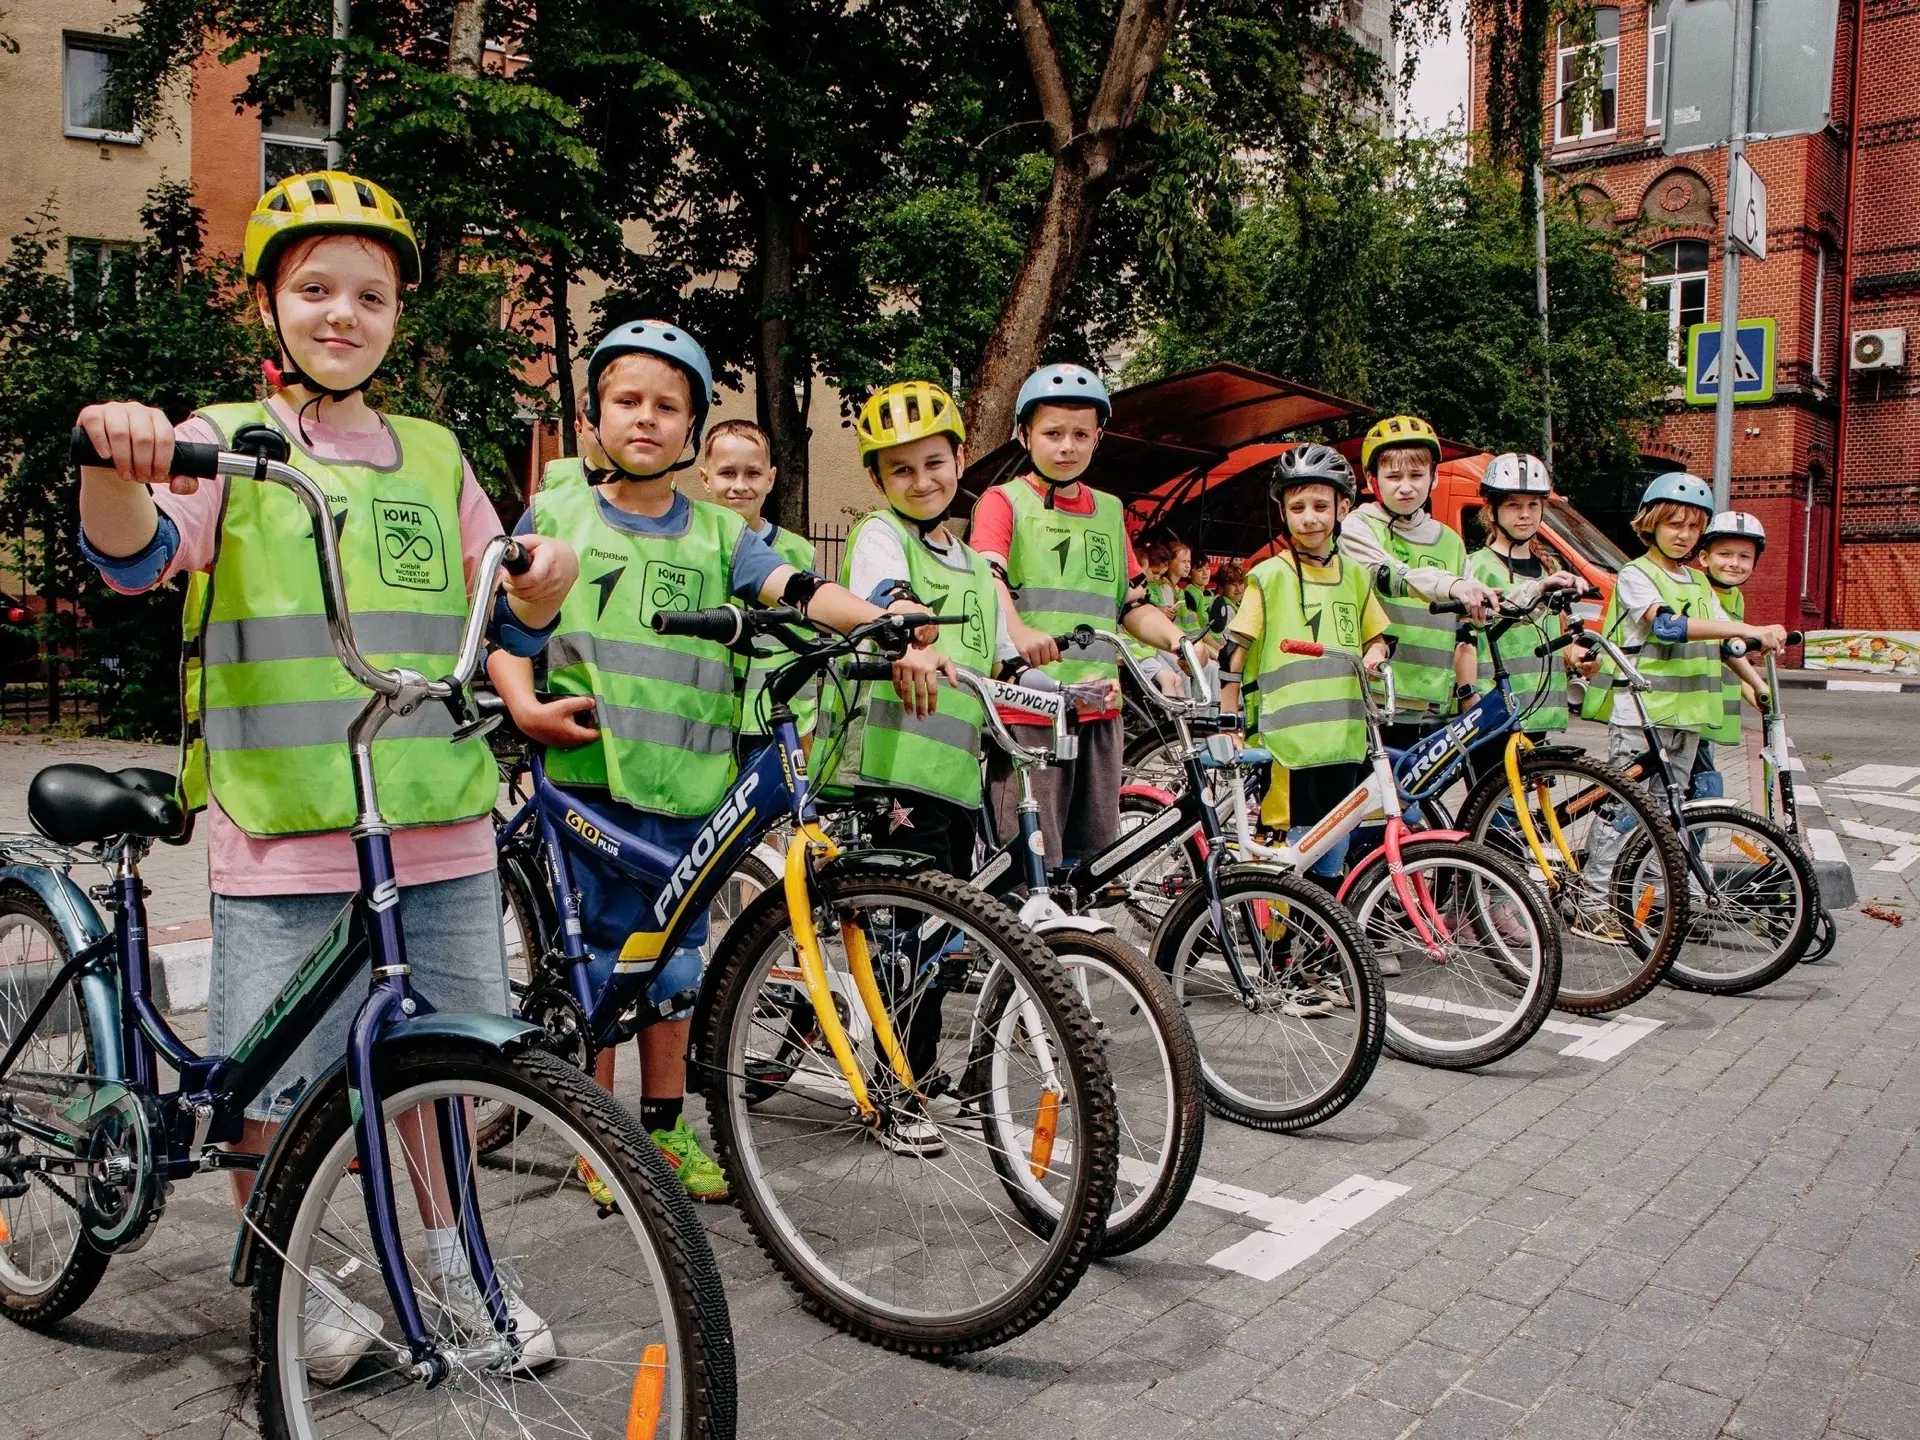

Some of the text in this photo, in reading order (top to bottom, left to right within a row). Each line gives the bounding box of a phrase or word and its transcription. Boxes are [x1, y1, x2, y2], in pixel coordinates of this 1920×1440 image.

[383, 509, 422, 526] ЮИД
[590, 548, 629, 563] Первые
[400, 562, 421, 570] ЮНЫЙ
[657, 567, 686, 586] ЮИД
[994, 681, 1059, 715] Forward
[778, 743, 795, 793] PROSP
[598, 838, 619, 857] PLUS
[653, 772, 760, 928] PROSP
